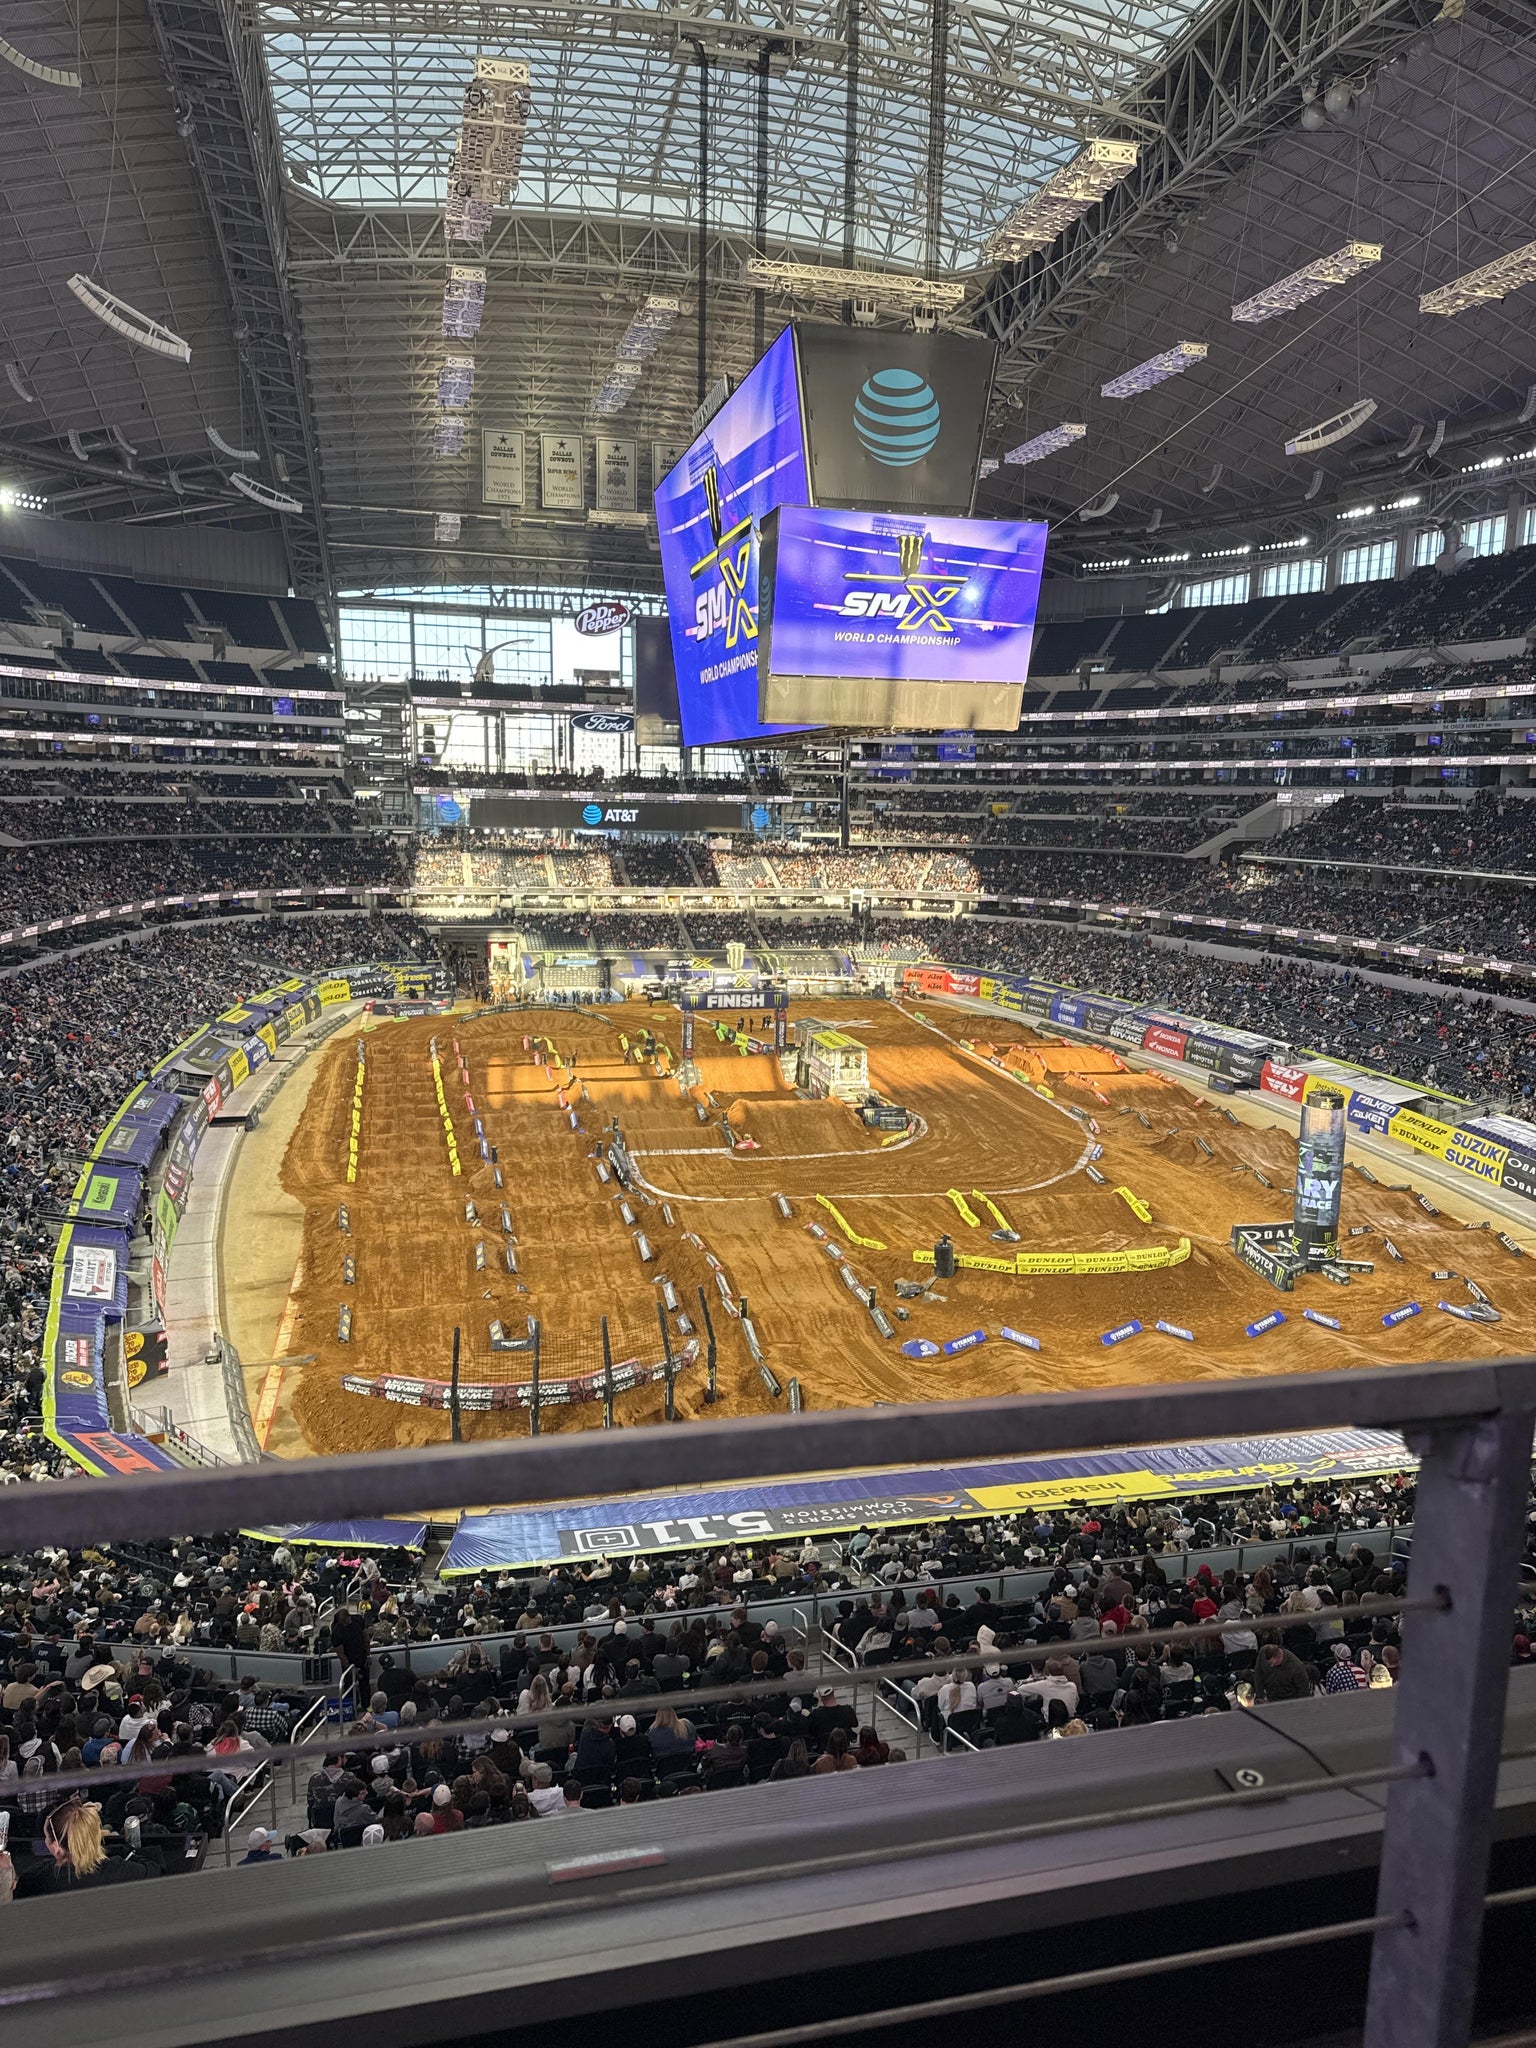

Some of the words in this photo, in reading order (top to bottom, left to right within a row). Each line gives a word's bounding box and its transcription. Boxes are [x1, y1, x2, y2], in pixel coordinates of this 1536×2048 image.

[487, 487, 521, 495] CHAMPIONS
[600, 495, 633, 503] CHAMPIONS
[597, 606, 616, 620] Dr
[838, 584, 960, 632] SMX
[581, 609, 627, 633] Pepper
[834, 632, 875, 643] WORLD
[877, 634, 961, 646] CHAMPIONSHIP
[700, 665, 719, 685] WORLD
[584, 715, 631, 731] Ford
[604, 809, 638, 822] AT&T
[667, 957, 714, 969] SMX
[716, 973, 754, 988] SMX
[707, 994, 764, 1008] FINISH
[1159, 1032, 1181, 1044] HONDA
[1156, 1044, 1179, 1057] HONDA
[1270, 1062, 1304, 1081] FLY
[1266, 1076, 1300, 1096] FLY
[1356, 1095, 1397, 1113] FALKEN
[1350, 1109, 1386, 1126] FALKEN
[1405, 1116, 1447, 1136] DUNLOP
[1400, 1129, 1440, 1151] DUNLOP
[1451, 1132, 1506, 1163] SUZUKI
[1445, 1149, 1500, 1181] SUZUKI
[1302, 1200, 1332, 1210] RACE
[1137, 1251, 1168, 1260] DUNLOP
[1243, 1242, 1274, 1273] MONSTER
[1308, 1244, 1337, 1258] SMX
[973, 1262, 1012, 1272] DUNLOP
[1139, 1261, 1167, 1270] DUNLOP
[1115, 1326, 1135, 1339] YAMAHA
[1353, 1458, 1420, 1470] OUNTAIN
[1016, 1481, 1126, 1500] Insta360
[782, 1501, 907, 1519] COMMISSION
[866, 1507, 914, 1518] UTAH
[785, 1514, 856, 1525] SPORTS
[642, 1511, 774, 1544] 5.11
